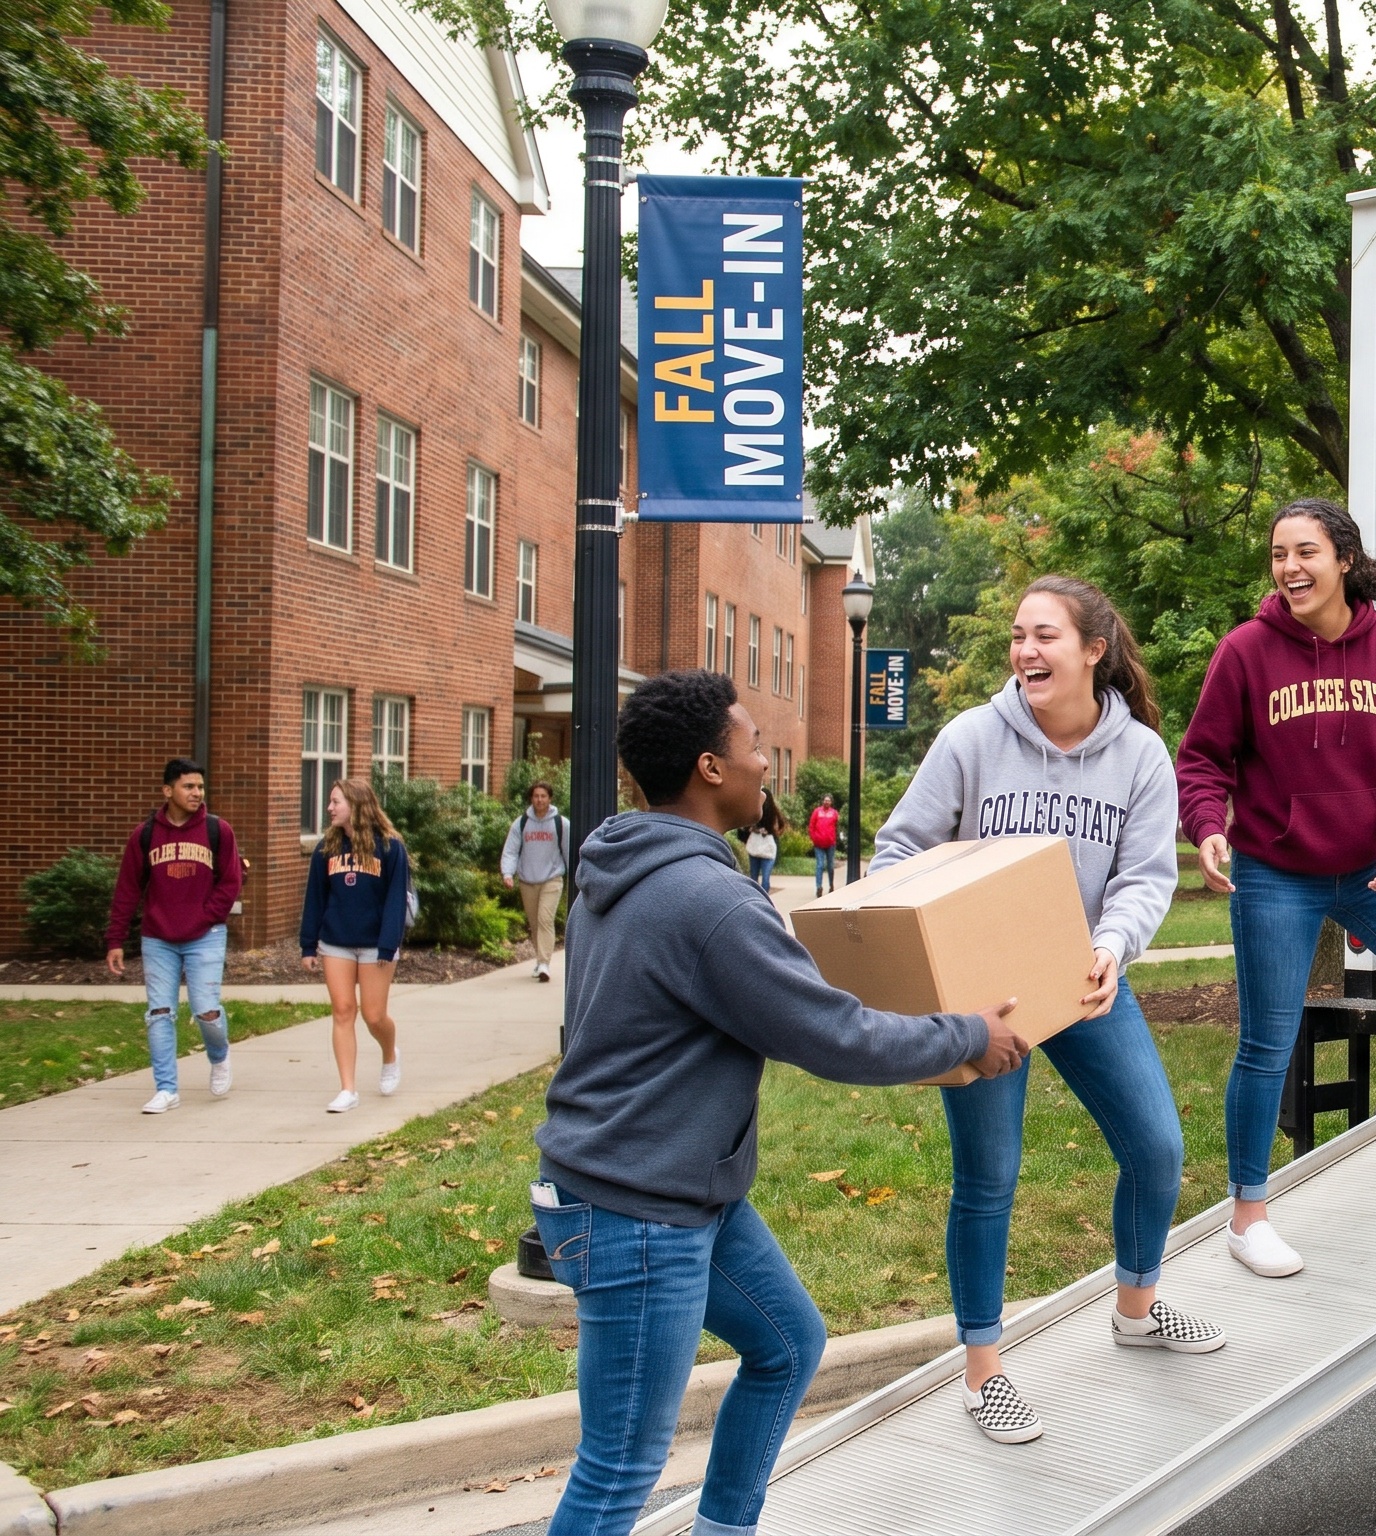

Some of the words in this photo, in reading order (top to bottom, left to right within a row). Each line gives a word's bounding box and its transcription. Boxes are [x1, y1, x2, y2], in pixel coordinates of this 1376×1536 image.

[654, 279, 715, 423] FALL
[722, 213, 785, 486] MOVE-IN
[869, 669, 887, 705] FALL
